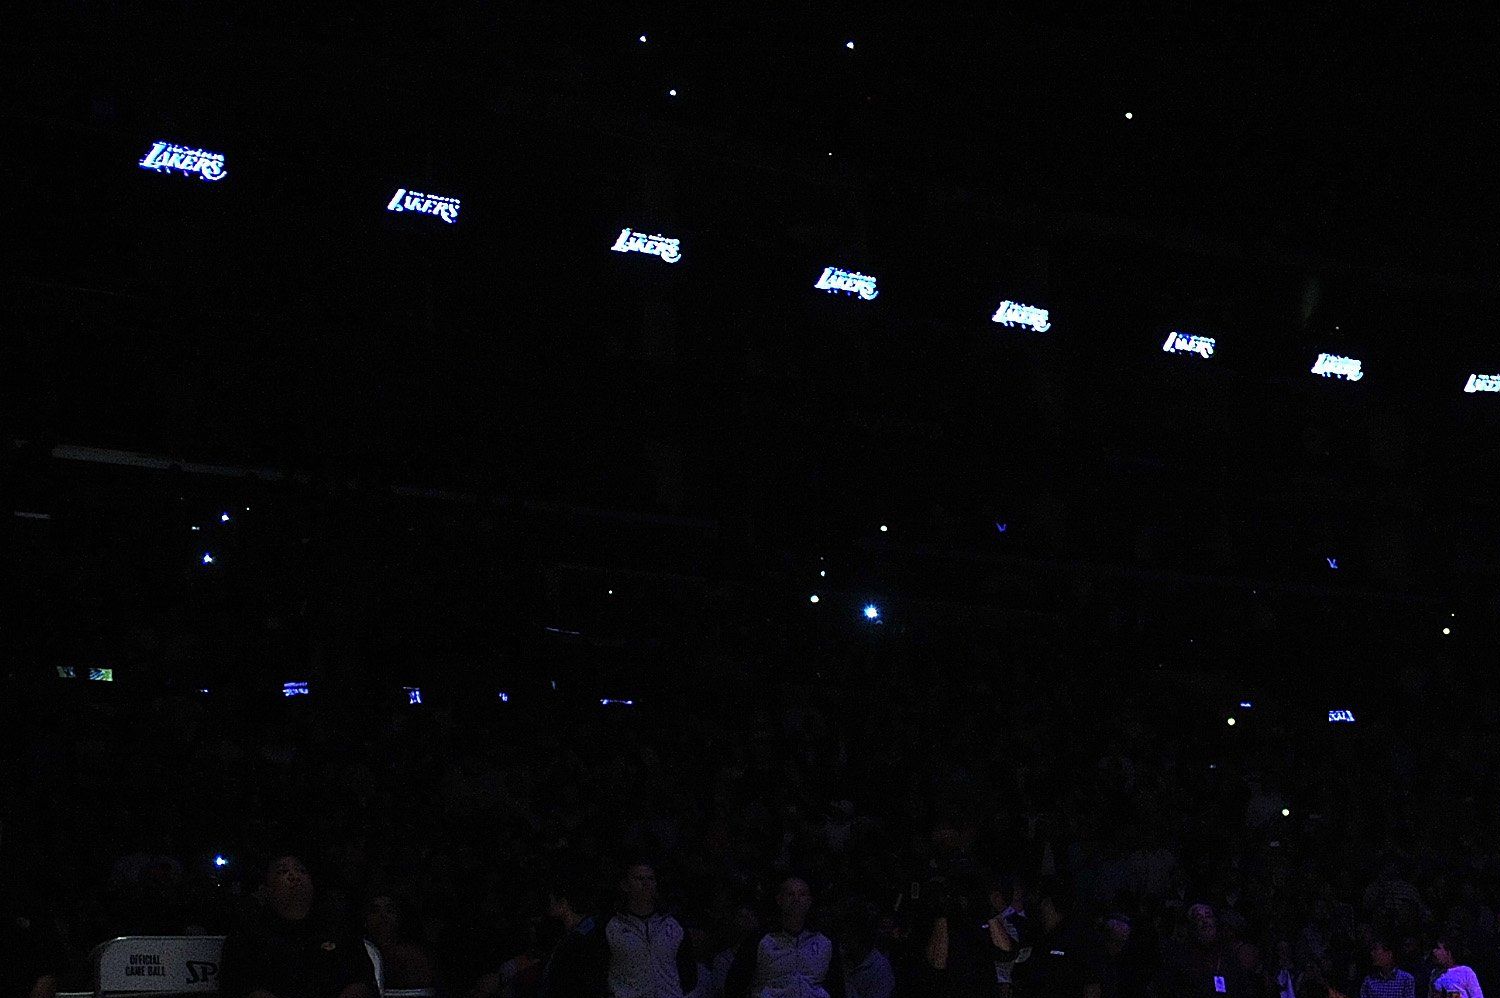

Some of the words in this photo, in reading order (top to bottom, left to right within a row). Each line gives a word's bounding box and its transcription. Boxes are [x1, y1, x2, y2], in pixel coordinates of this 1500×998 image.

[139, 141, 228, 182] LAKERS
[387, 189, 460, 223] LAKERS
[611, 228, 681, 263] LAKERS
[814, 267, 879, 300] LAKERS
